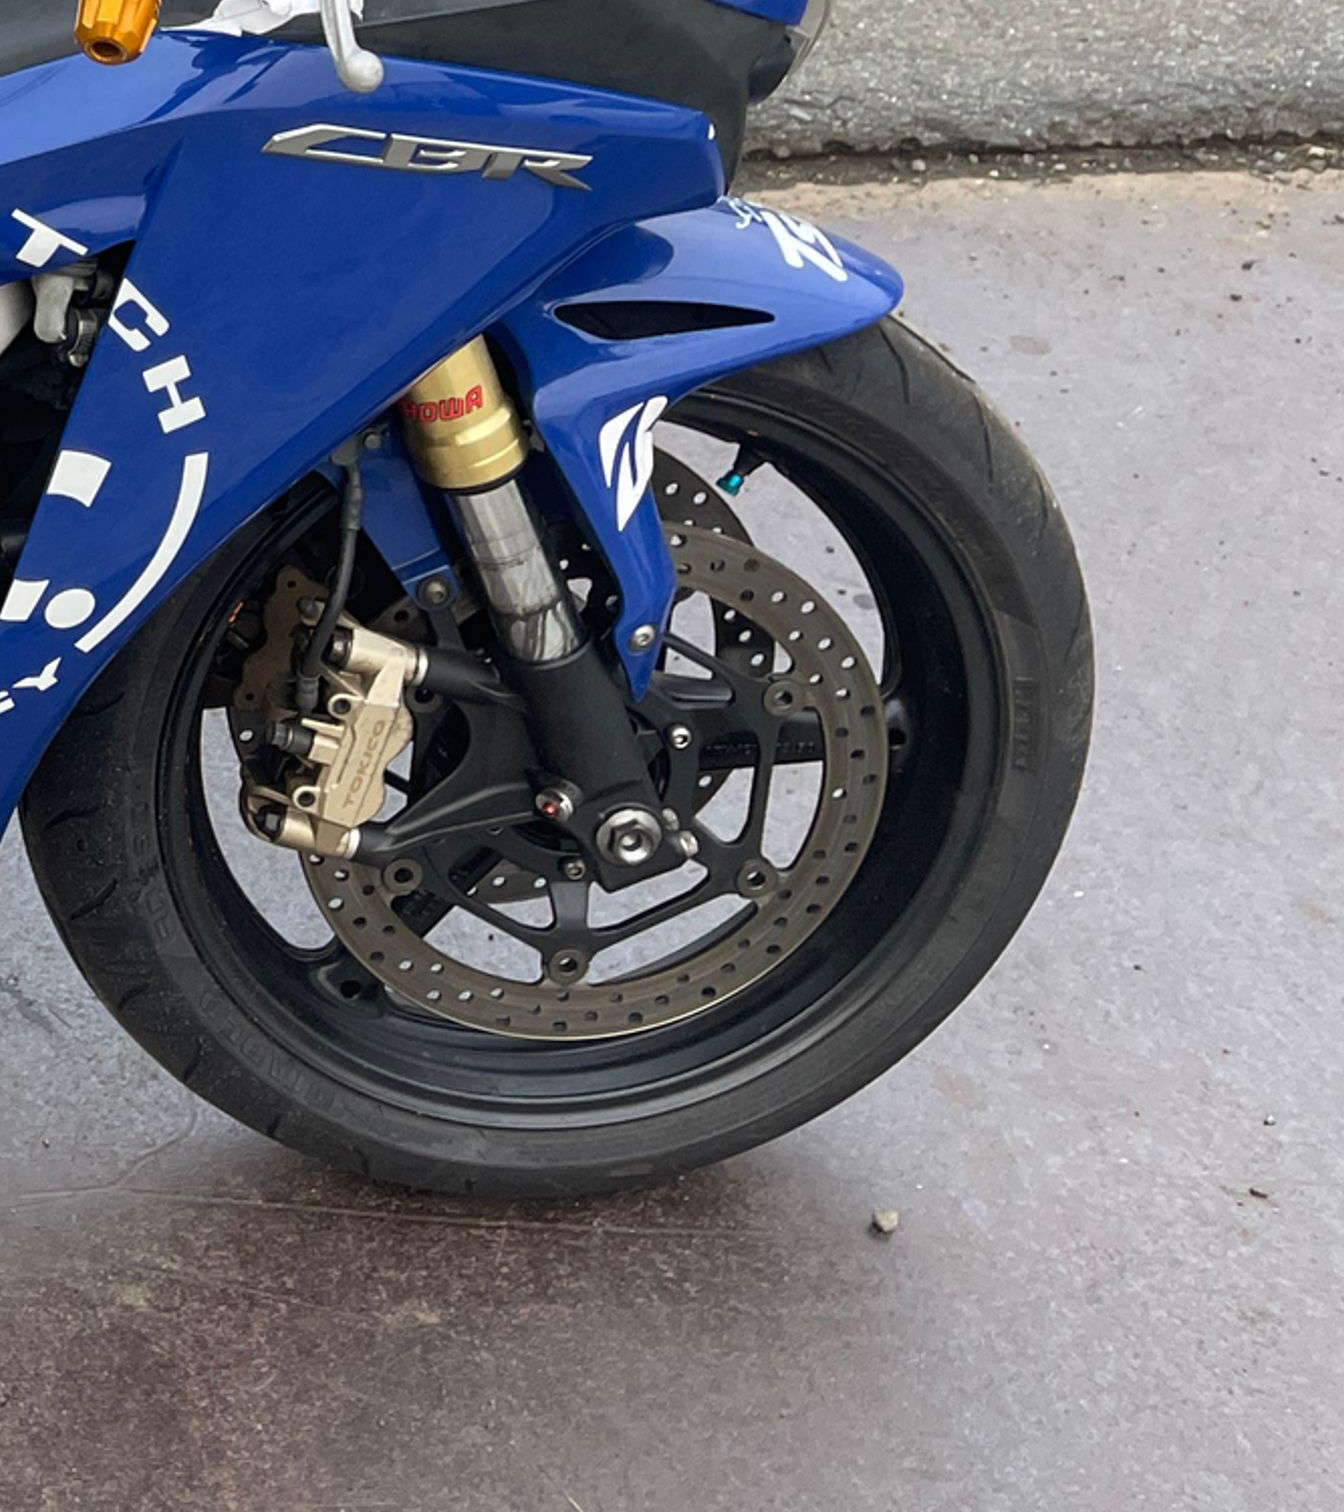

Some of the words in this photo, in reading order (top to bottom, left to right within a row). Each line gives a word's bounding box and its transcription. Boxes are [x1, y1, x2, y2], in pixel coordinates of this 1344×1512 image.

[261, 124, 593, 191] CBR
[400, 384, 483, 424] HOWA
[343, 718, 387, 809] TOKICO
